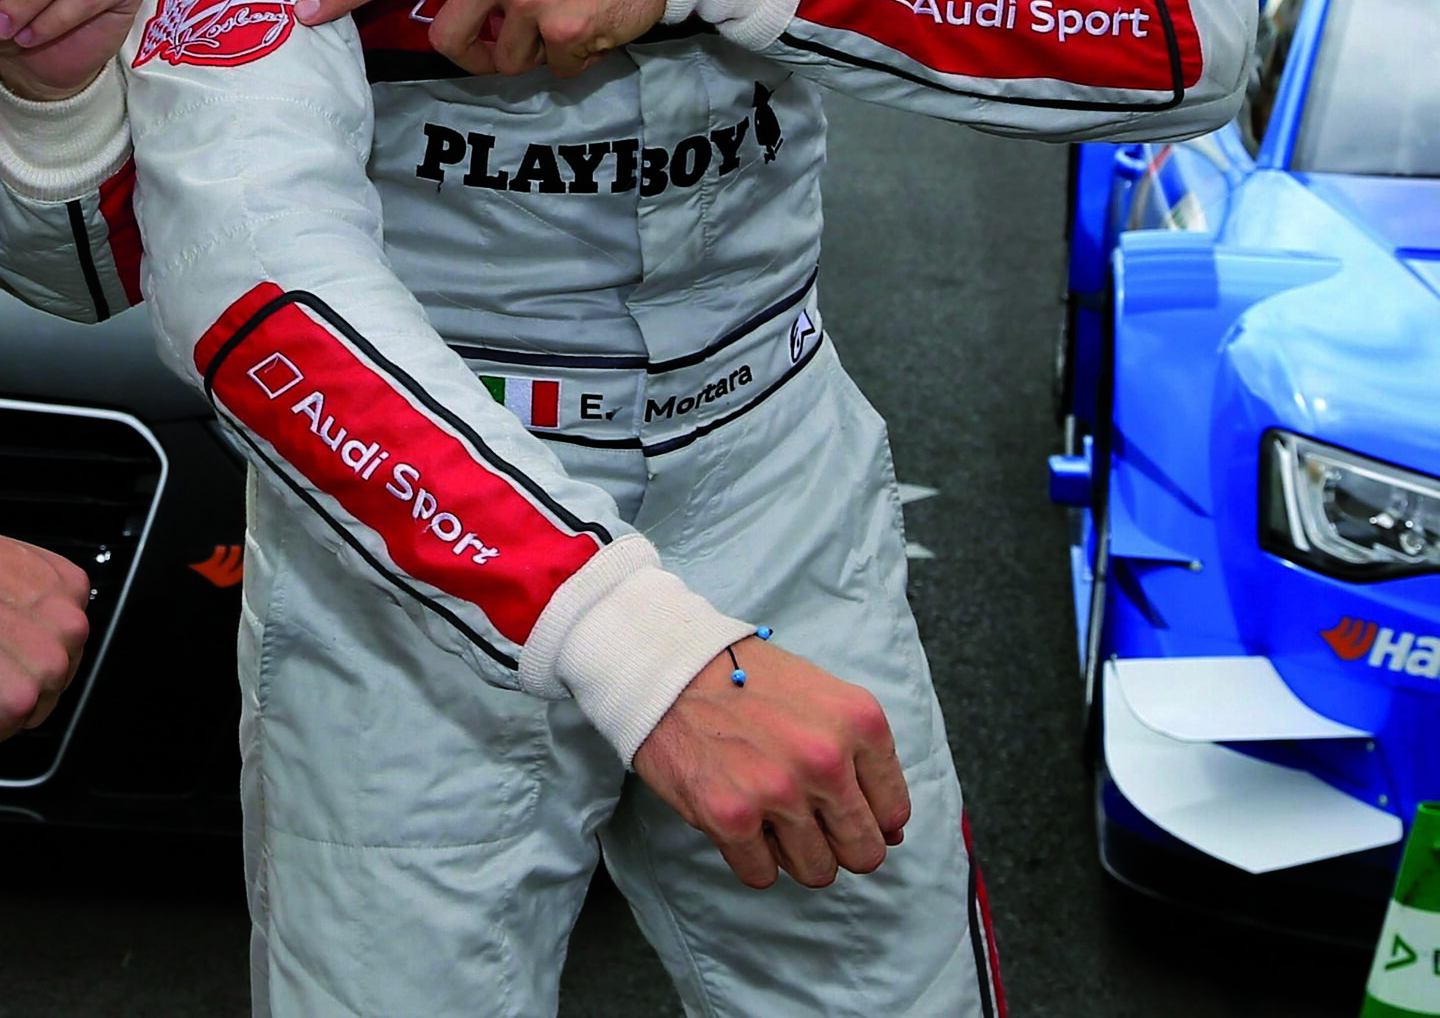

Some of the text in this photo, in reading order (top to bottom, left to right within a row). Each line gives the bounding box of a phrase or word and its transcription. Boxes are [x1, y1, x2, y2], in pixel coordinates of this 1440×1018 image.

[1029, 0, 1150, 42] Sport
[416, 116, 750, 197] PLAYBOY
[644, 365, 753, 423] Mortara
[291, 390, 500, 566] Audi Sport
[1368, 627, 1440, 679] Ha
